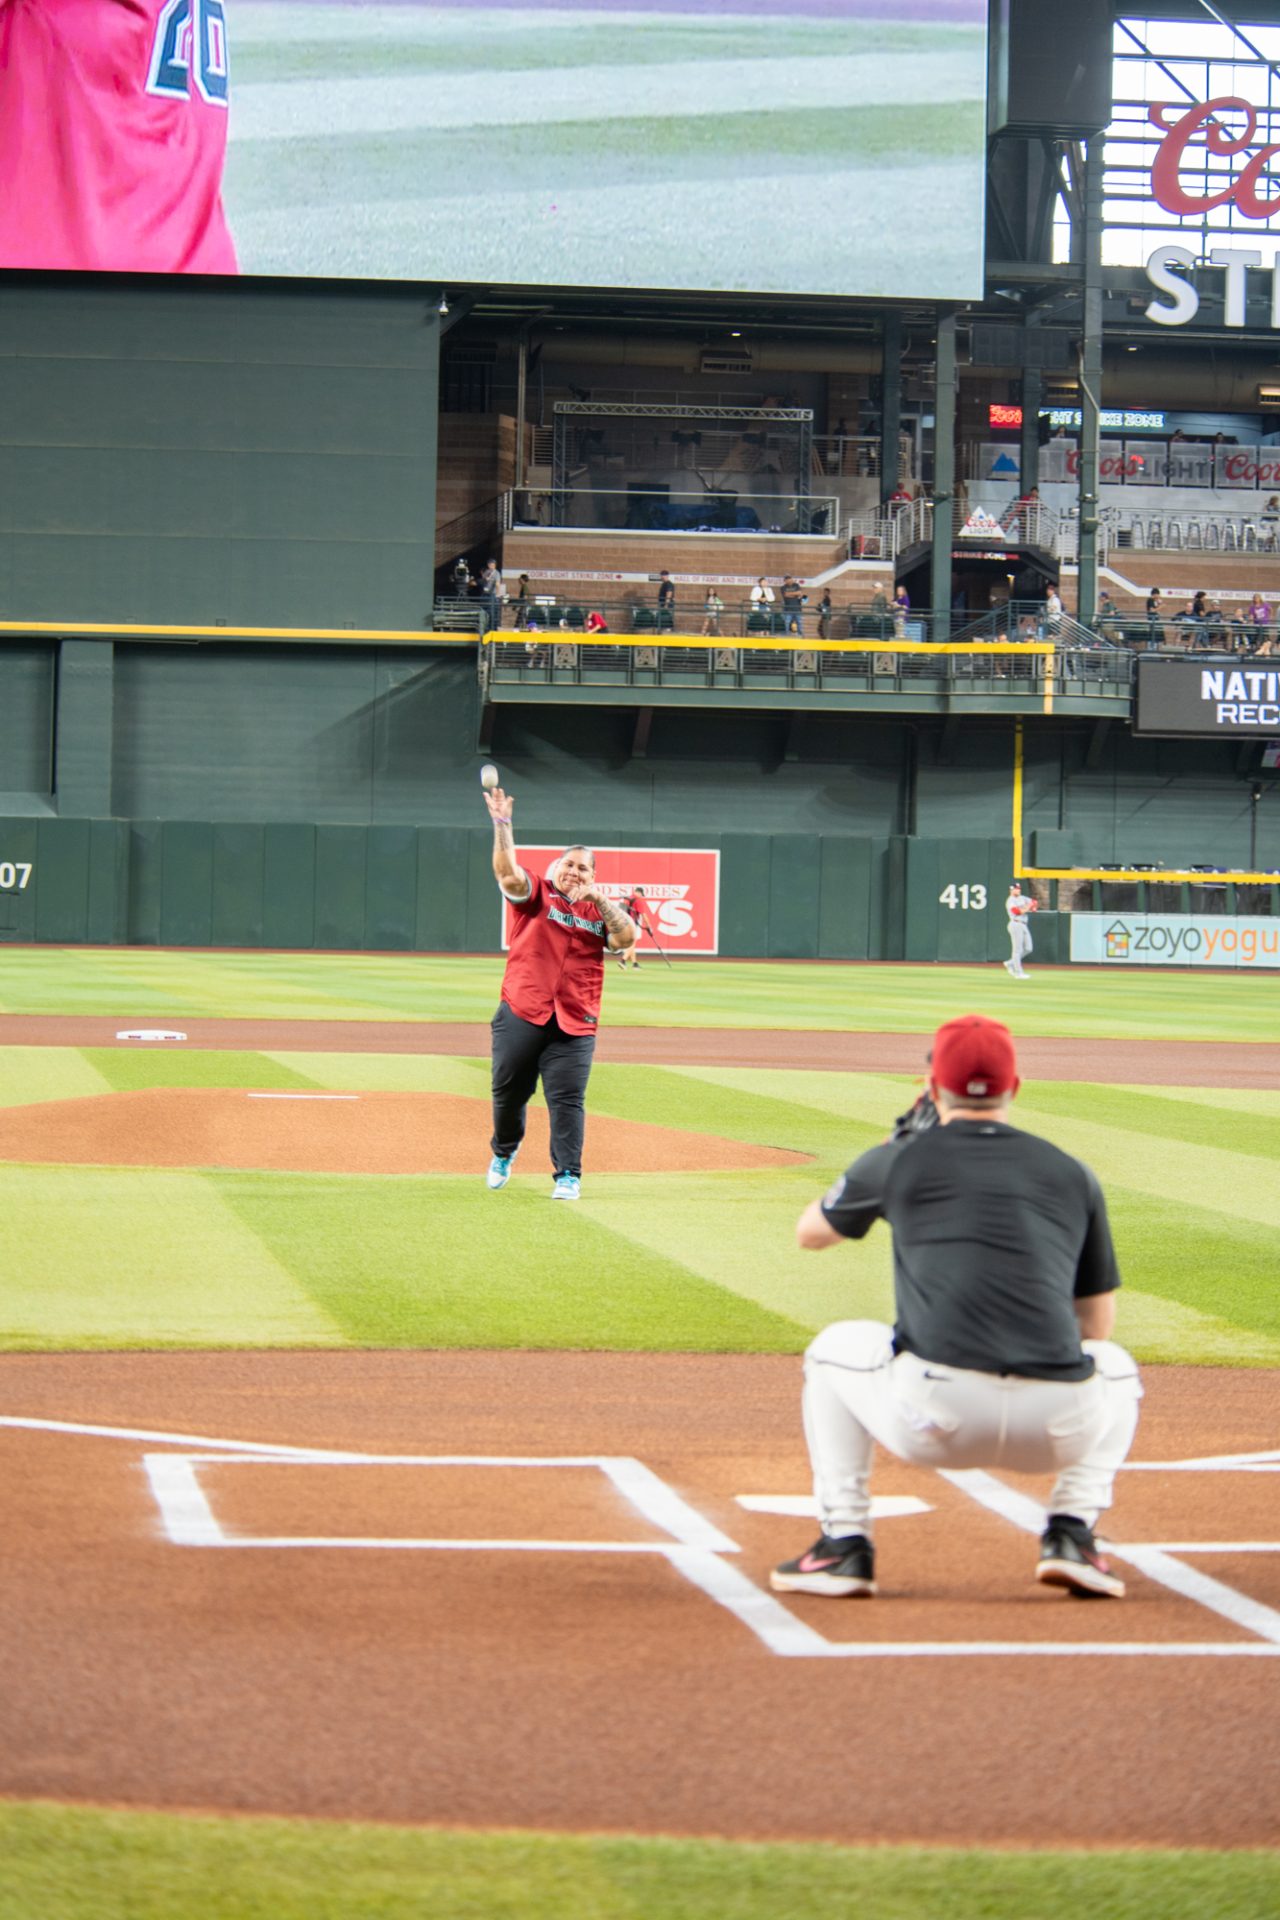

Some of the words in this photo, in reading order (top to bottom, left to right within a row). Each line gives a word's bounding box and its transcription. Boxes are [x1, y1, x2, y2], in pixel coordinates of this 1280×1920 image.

[1145, 245, 1280, 326] ST
[1124, 413, 1164, 427] ZONE
[1143, 458, 1208, 479] LIGHT
[1201, 670, 1280, 701] NATI
[939, 884, 988, 910] 413
